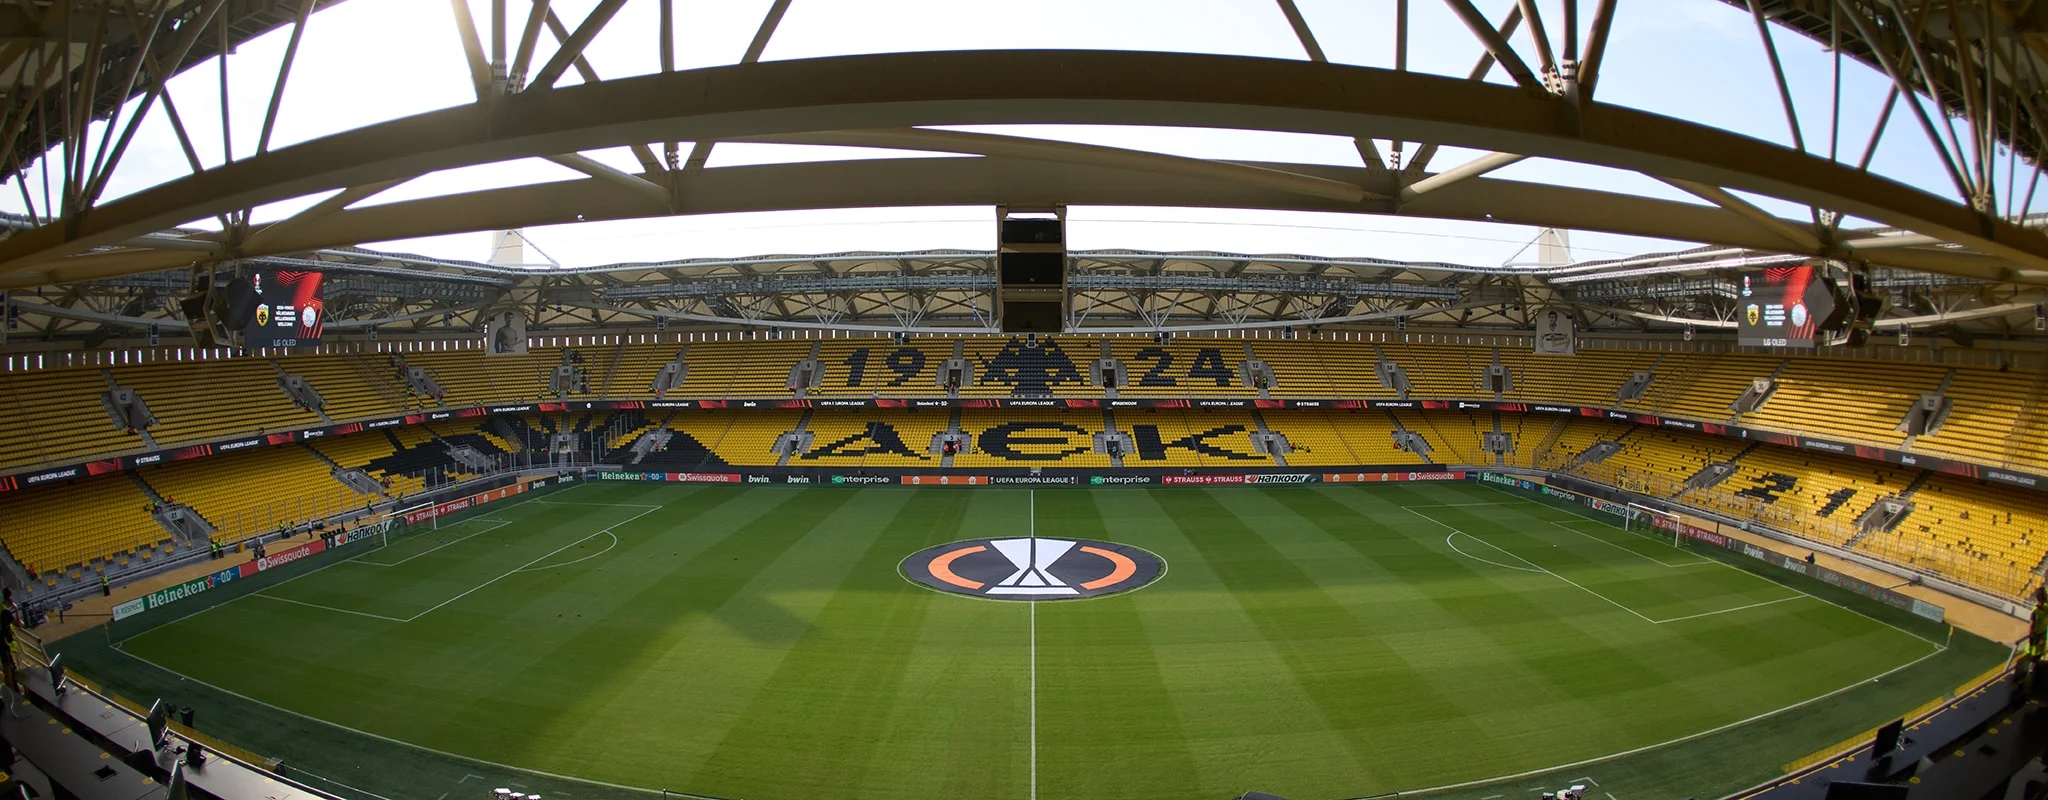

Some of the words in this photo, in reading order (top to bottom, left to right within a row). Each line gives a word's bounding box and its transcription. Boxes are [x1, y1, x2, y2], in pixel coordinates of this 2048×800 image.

[1763, 338, 1771, 346] LG
[1771, 338, 1787, 346] OLED
[846, 348, 926, 387] 19
[1133, 348, 1236, 388] 24
[140, 454, 161, 464] STRAUSS
[27, 475, 41, 483] UEFA
[41, 472, 58, 481] EUROPA
[58, 470, 76, 479] LEAGUE
[602, 471, 640, 480] Heineken
[687, 473, 728, 482] Swissquote
[832, 475, 889, 484] enterprise
[1091, 475, 1150, 485] enterprise
[1416, 472, 1454, 480] Swissquote
[1483, 472, 1516, 486] Heineken
[1542, 485, 1576, 501] enterprise
[446, 500, 468, 513] STRAUSS
[416, 508, 439, 521] STRAUSS
[1661, 520, 1687, 533] STRAUSS
[1696, 529, 1723, 545] STRAUSS
[266, 545, 310, 568] Swissquote
[148, 580, 206, 609] Heineken
[120, 602, 143, 614] RESPECT
